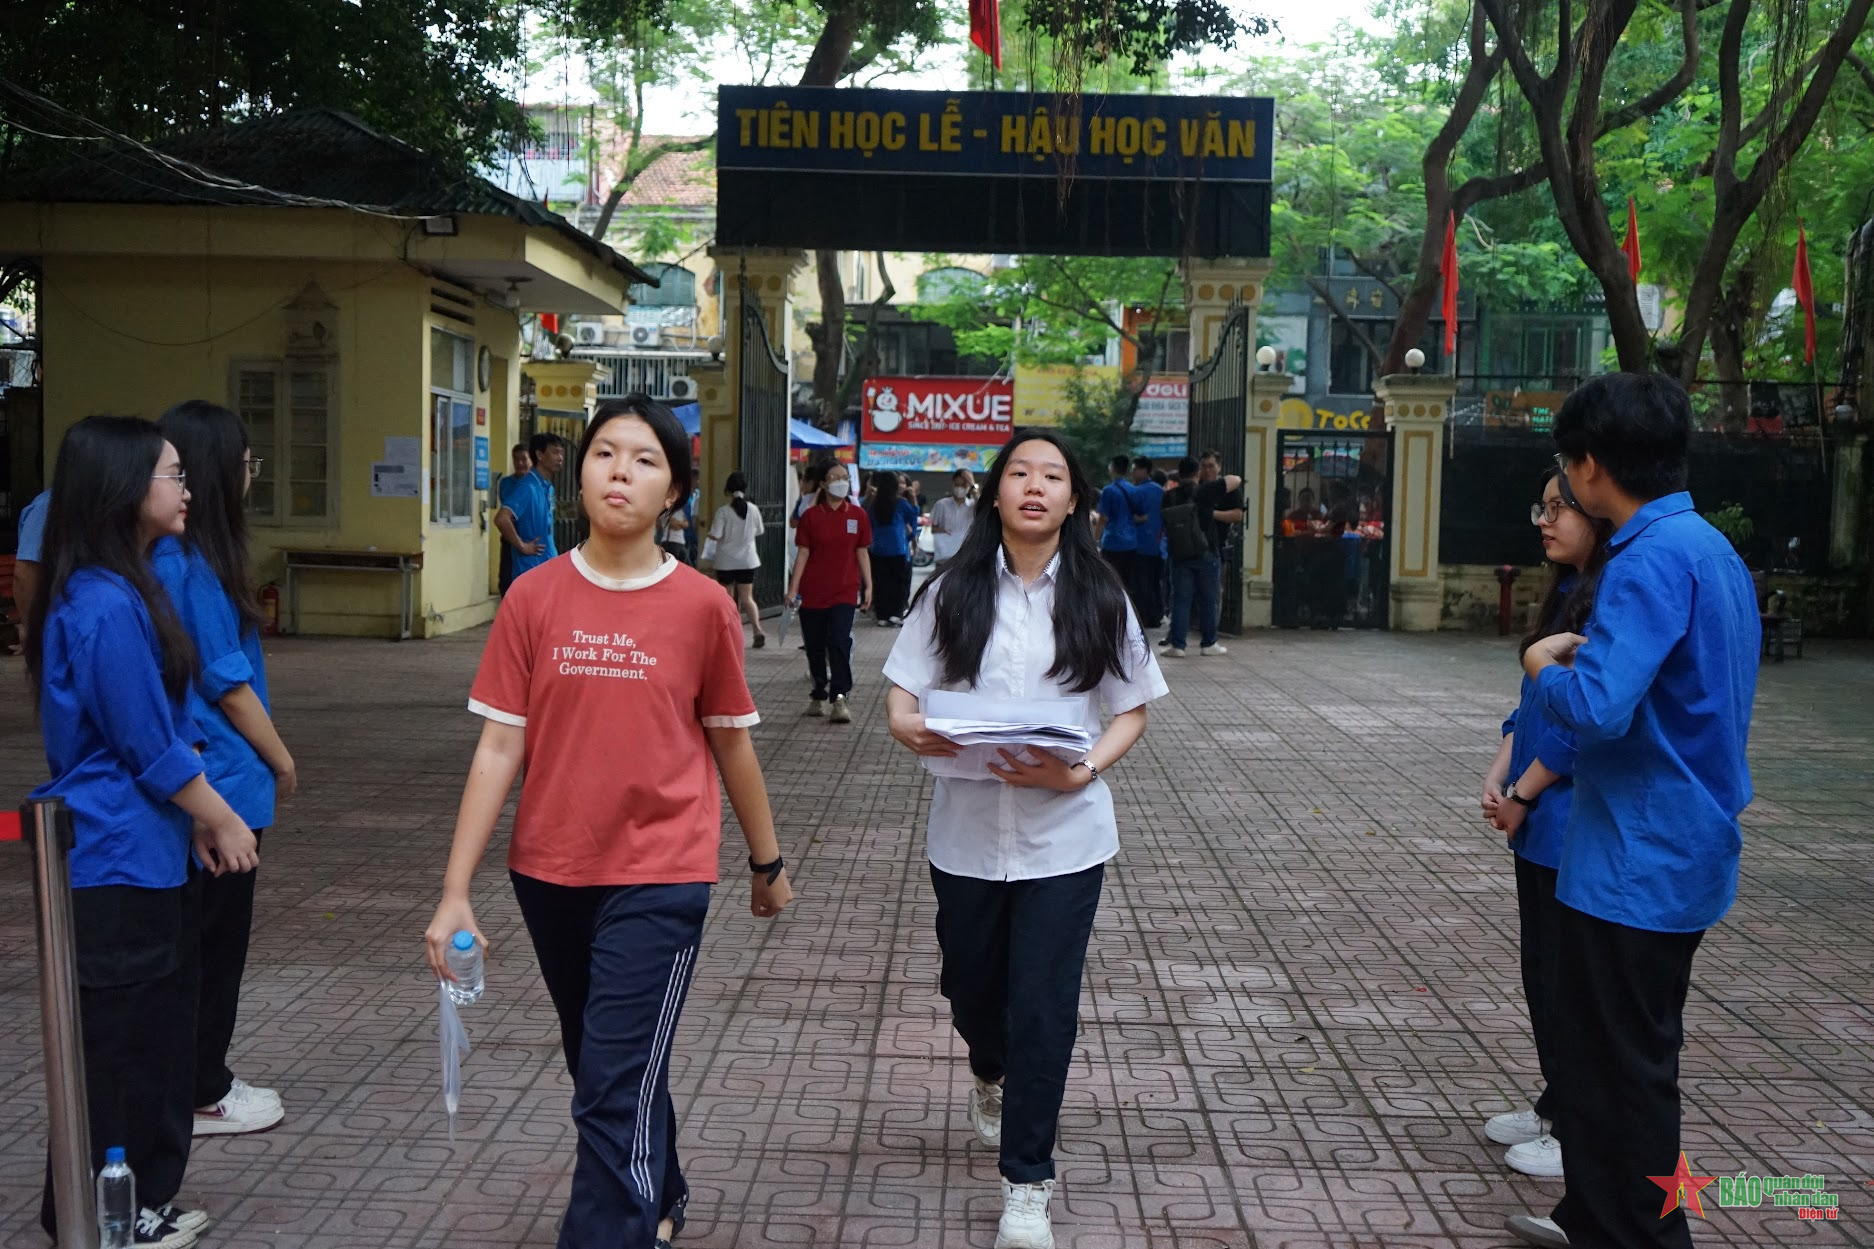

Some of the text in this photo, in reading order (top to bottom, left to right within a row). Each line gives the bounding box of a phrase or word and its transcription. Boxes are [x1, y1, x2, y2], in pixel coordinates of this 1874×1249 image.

[736, 98, 1256, 165] TIÊN HỌC LỄ - HẬU HỌC VĂN
[1146, 384, 1188, 398] deli
[905, 393, 1011, 422] MIXUE
[572, 630, 637, 648] Trust Me,
[552, 646, 657, 665] I Work For The
[559, 662, 648, 680] Government.
